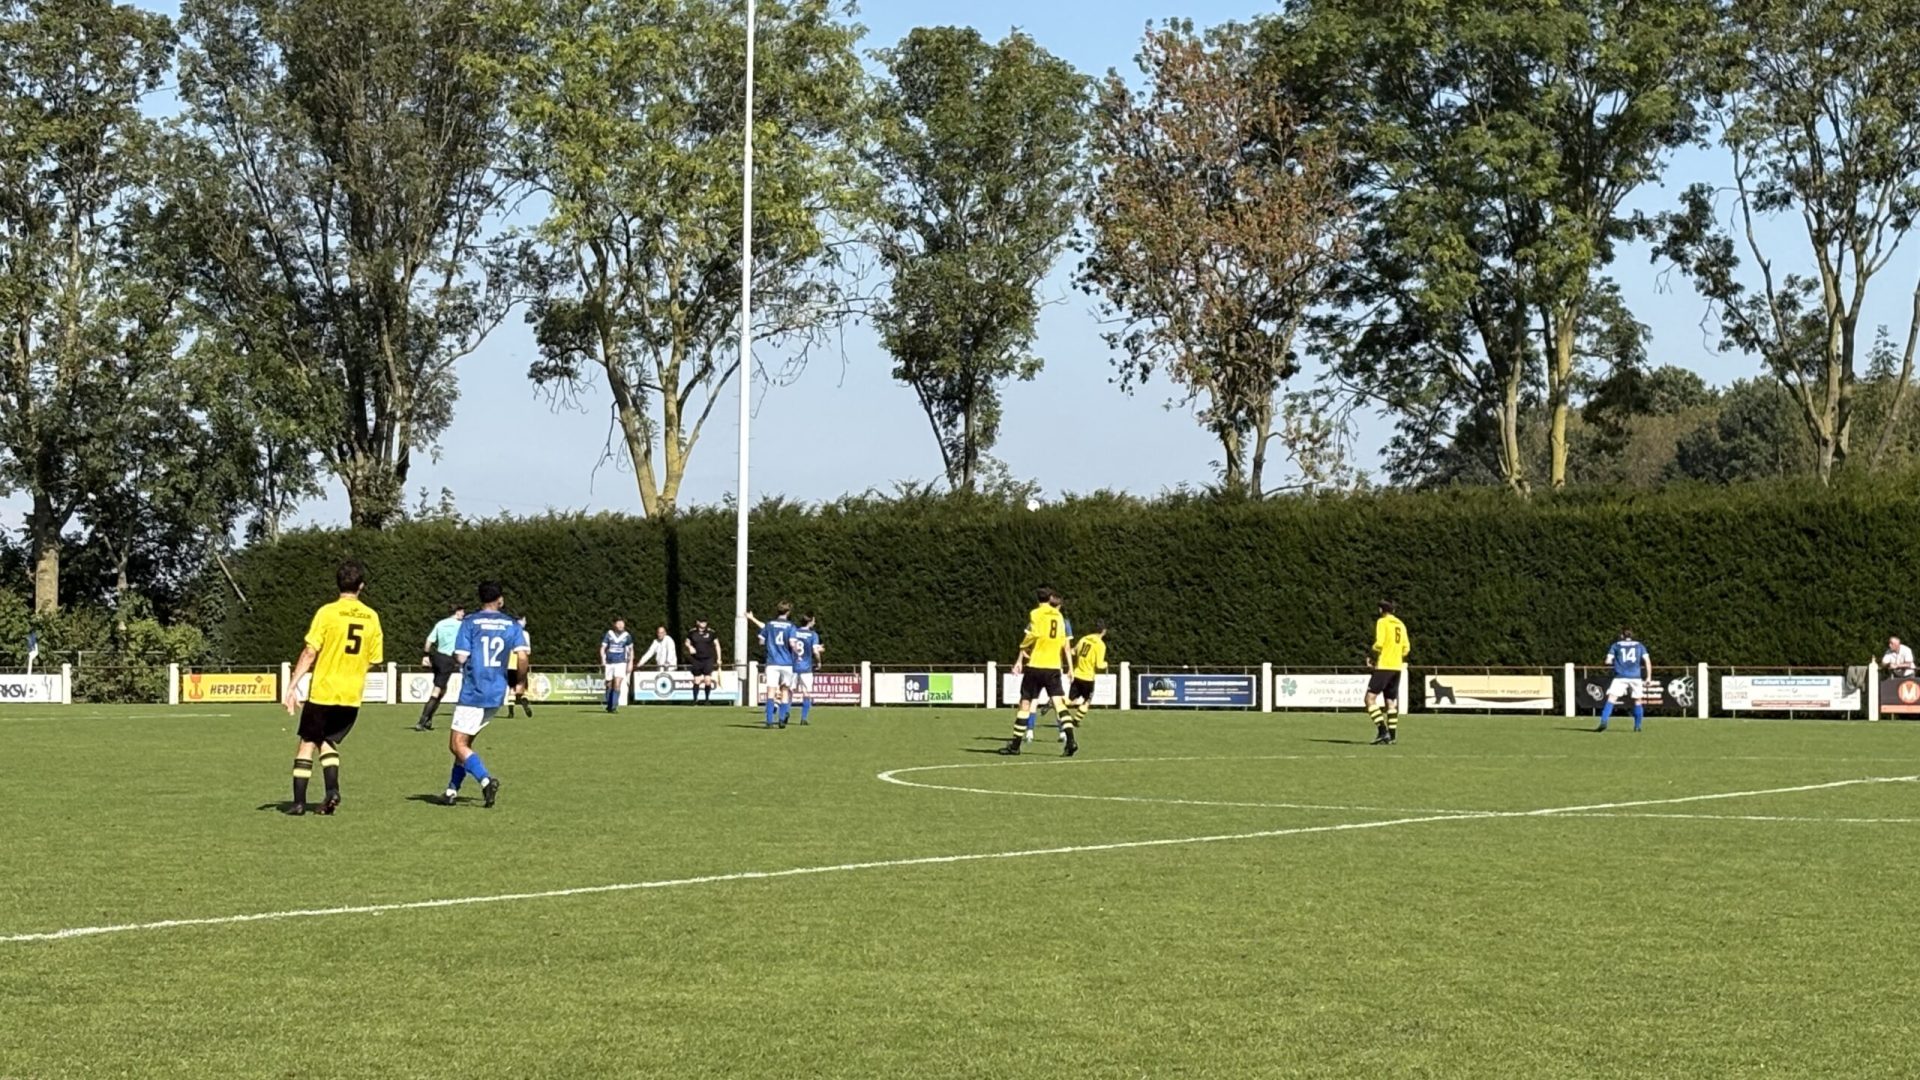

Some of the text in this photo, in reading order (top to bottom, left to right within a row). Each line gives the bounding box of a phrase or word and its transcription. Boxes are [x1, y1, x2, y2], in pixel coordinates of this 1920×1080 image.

[1049, 619, 1058, 639] 8
[1395, 627, 1401, 644] 6
[344, 623, 364, 655] 5
[775, 631, 785, 645] 4
[480, 636, 505, 667] 12
[1080, 641, 1091, 658] 10
[1620, 647, 1637, 663] 14
[906, 679, 920, 690] de
[1901, 683, 1917, 699] M
[906, 690, 953, 701] Verfzaak
